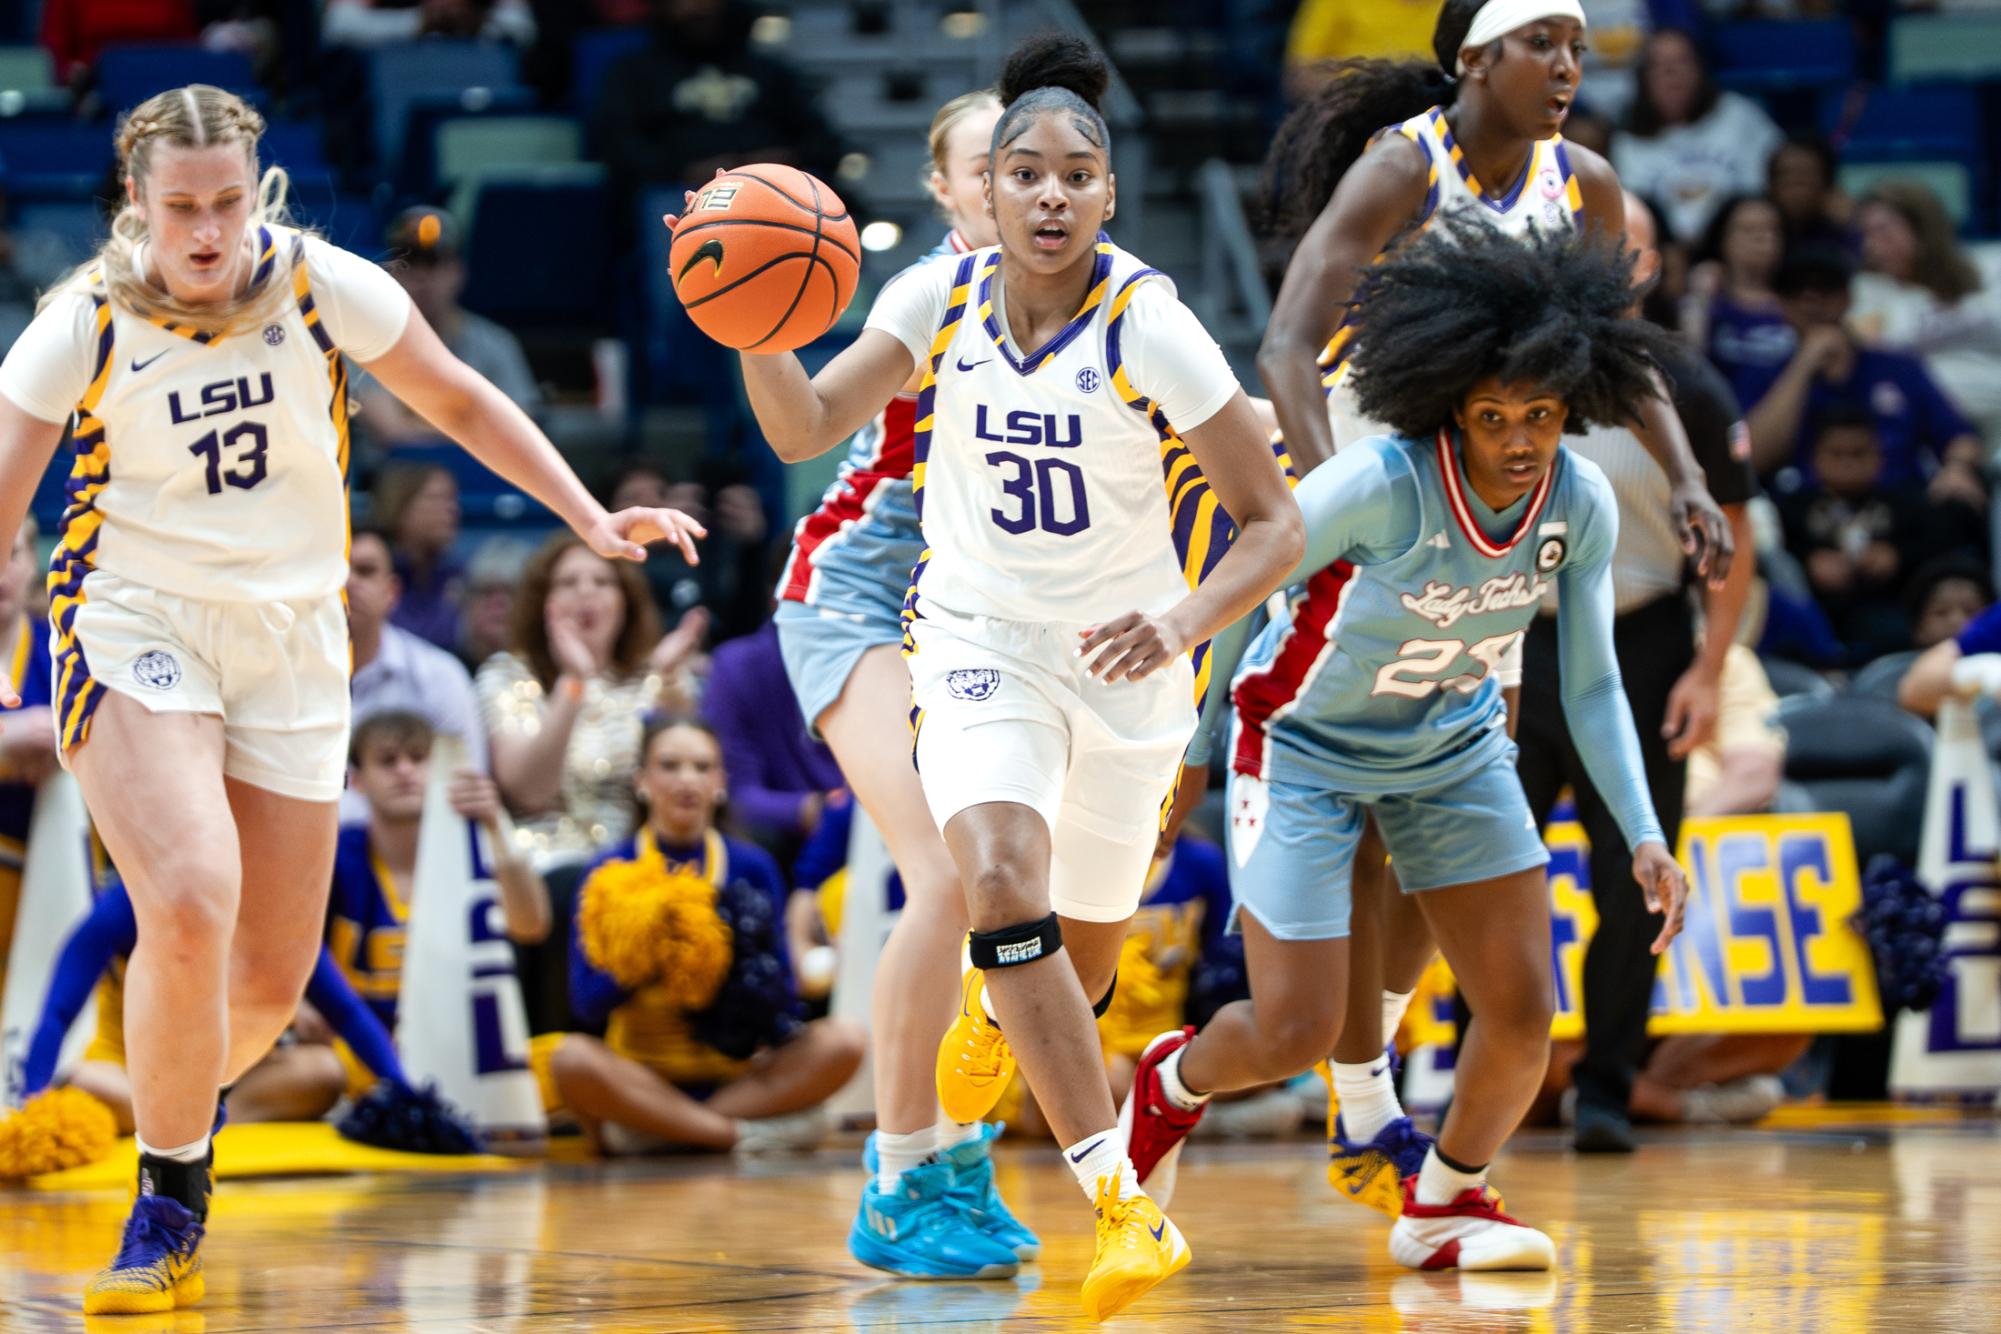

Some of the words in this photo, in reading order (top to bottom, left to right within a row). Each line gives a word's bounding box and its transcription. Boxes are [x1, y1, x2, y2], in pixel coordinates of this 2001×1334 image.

[168, 371, 274, 425] LSU
[1077, 367, 1099, 392] SEC
[976, 404, 1082, 448] LSU
[188, 420, 268, 495] 13
[985, 451, 1090, 536] 30
[1400, 569, 1471, 628] Lady
